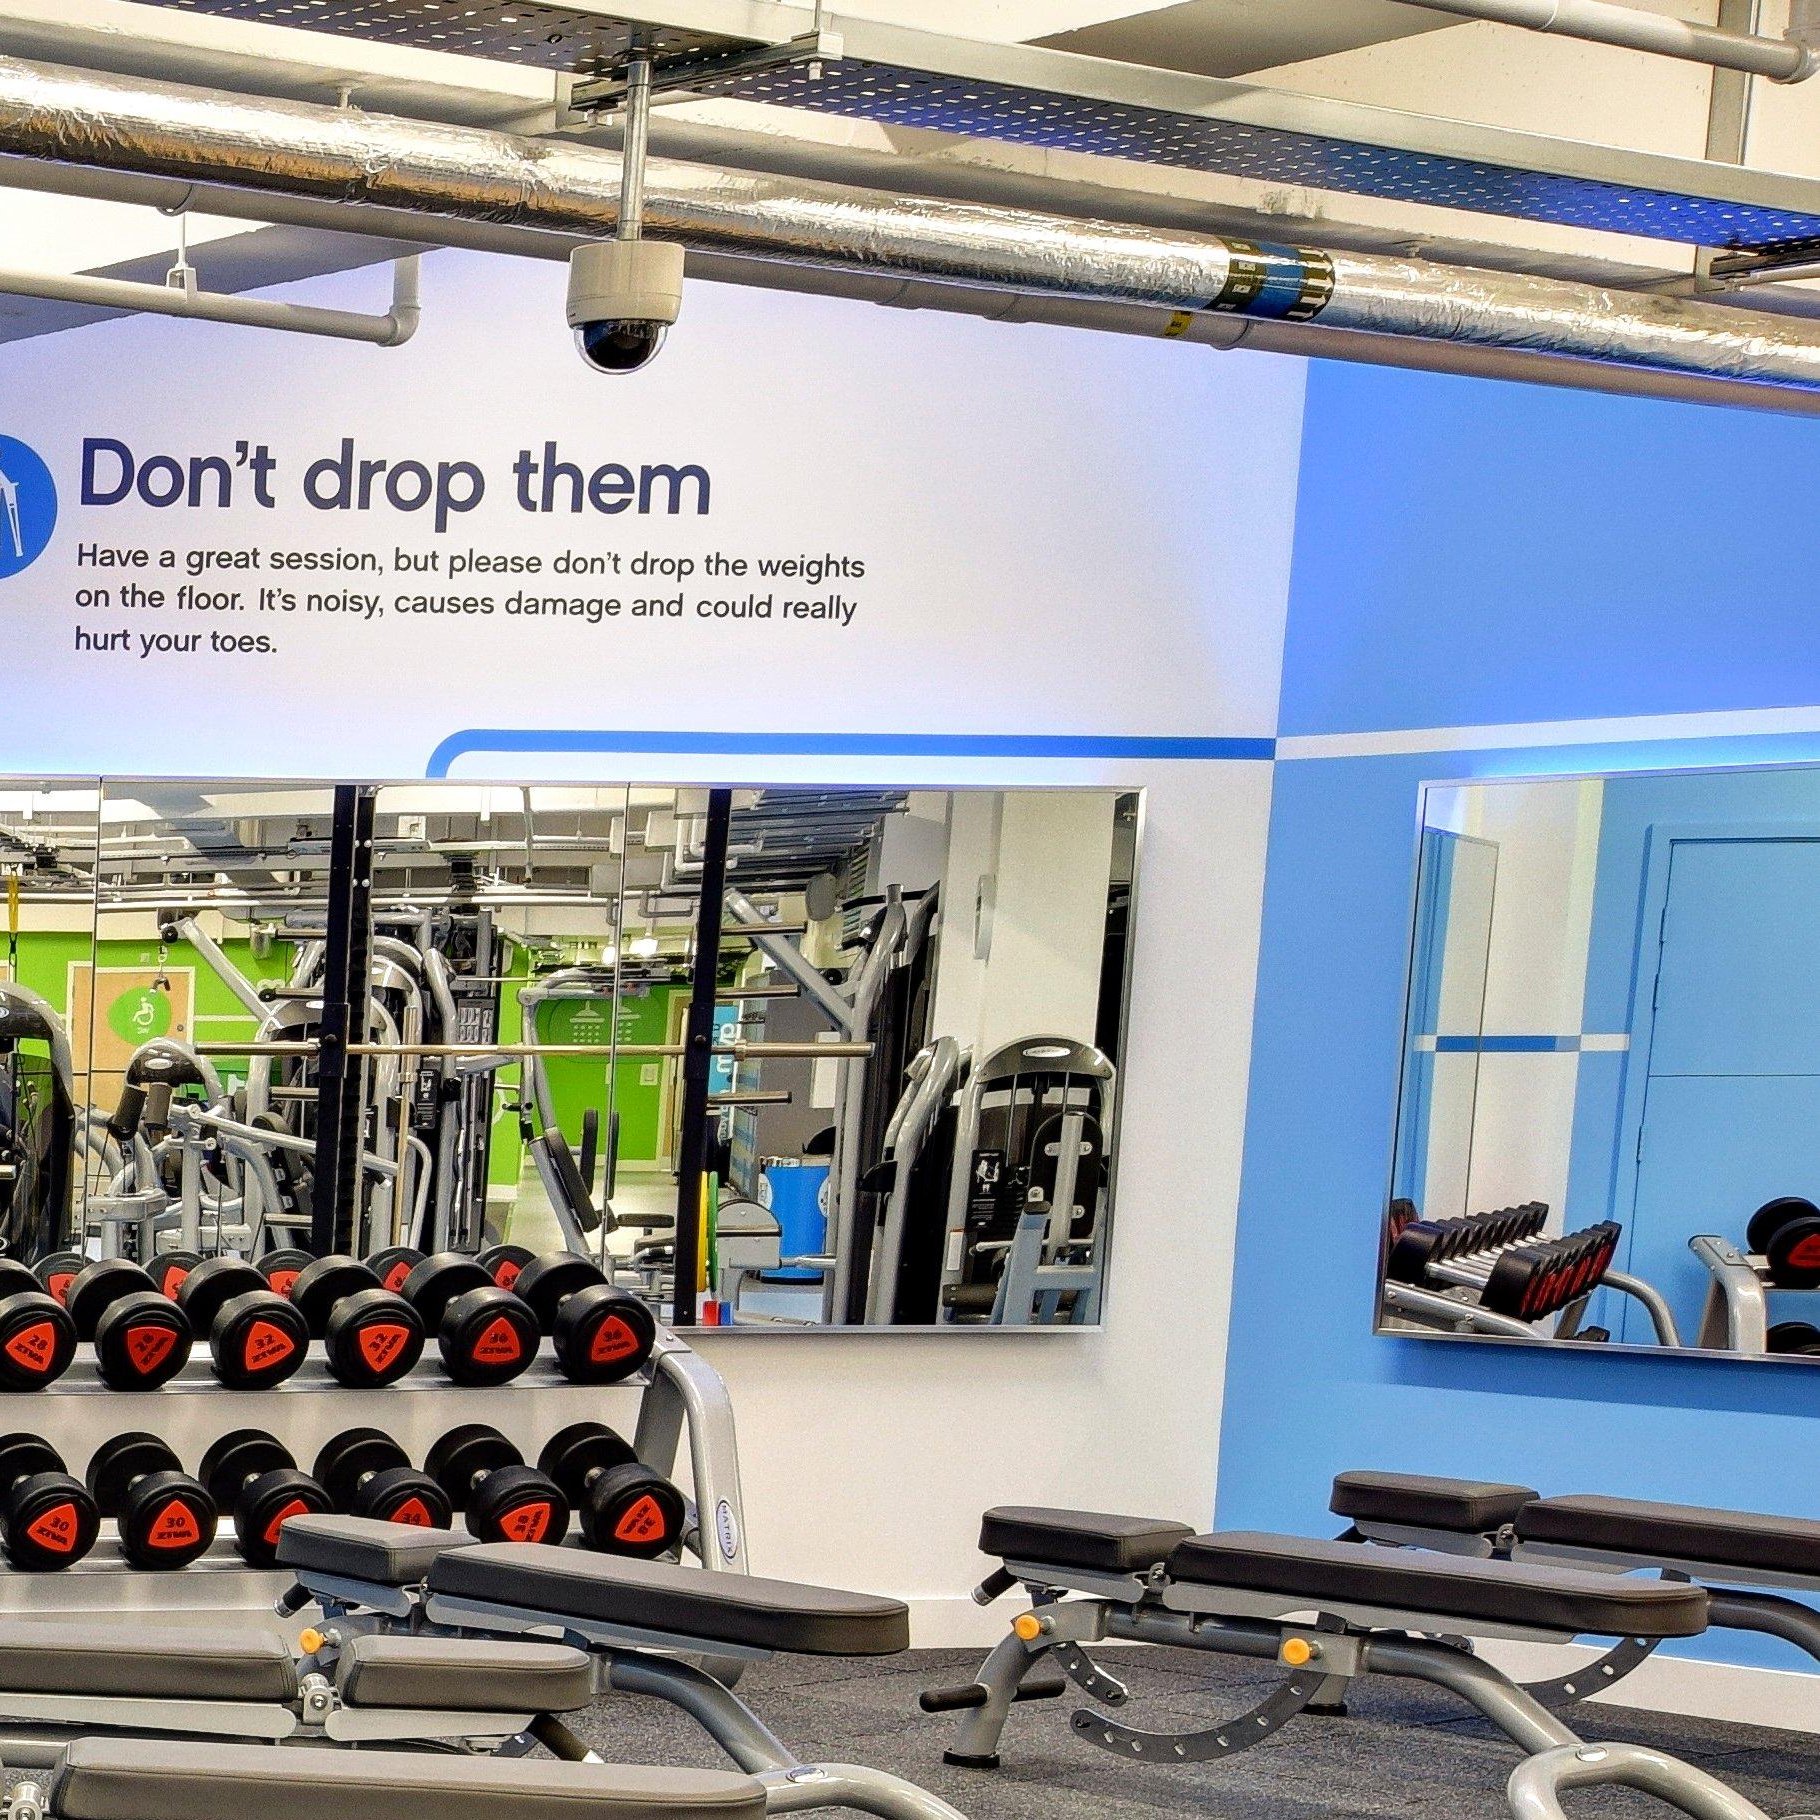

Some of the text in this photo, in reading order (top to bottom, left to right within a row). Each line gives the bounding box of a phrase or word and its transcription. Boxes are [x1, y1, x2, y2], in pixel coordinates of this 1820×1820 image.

[81, 438, 710, 533] Don't drop them
[78, 543, 864, 585] Have a great session, but please don't drop the weights
[76, 583, 857, 626] on the floor. It's noisy, causes damage and could really
[76, 626, 276, 658] hurt your toes.
[166, 1517, 186, 1528] 30
[719, 1505, 733, 1556] MATRIX
